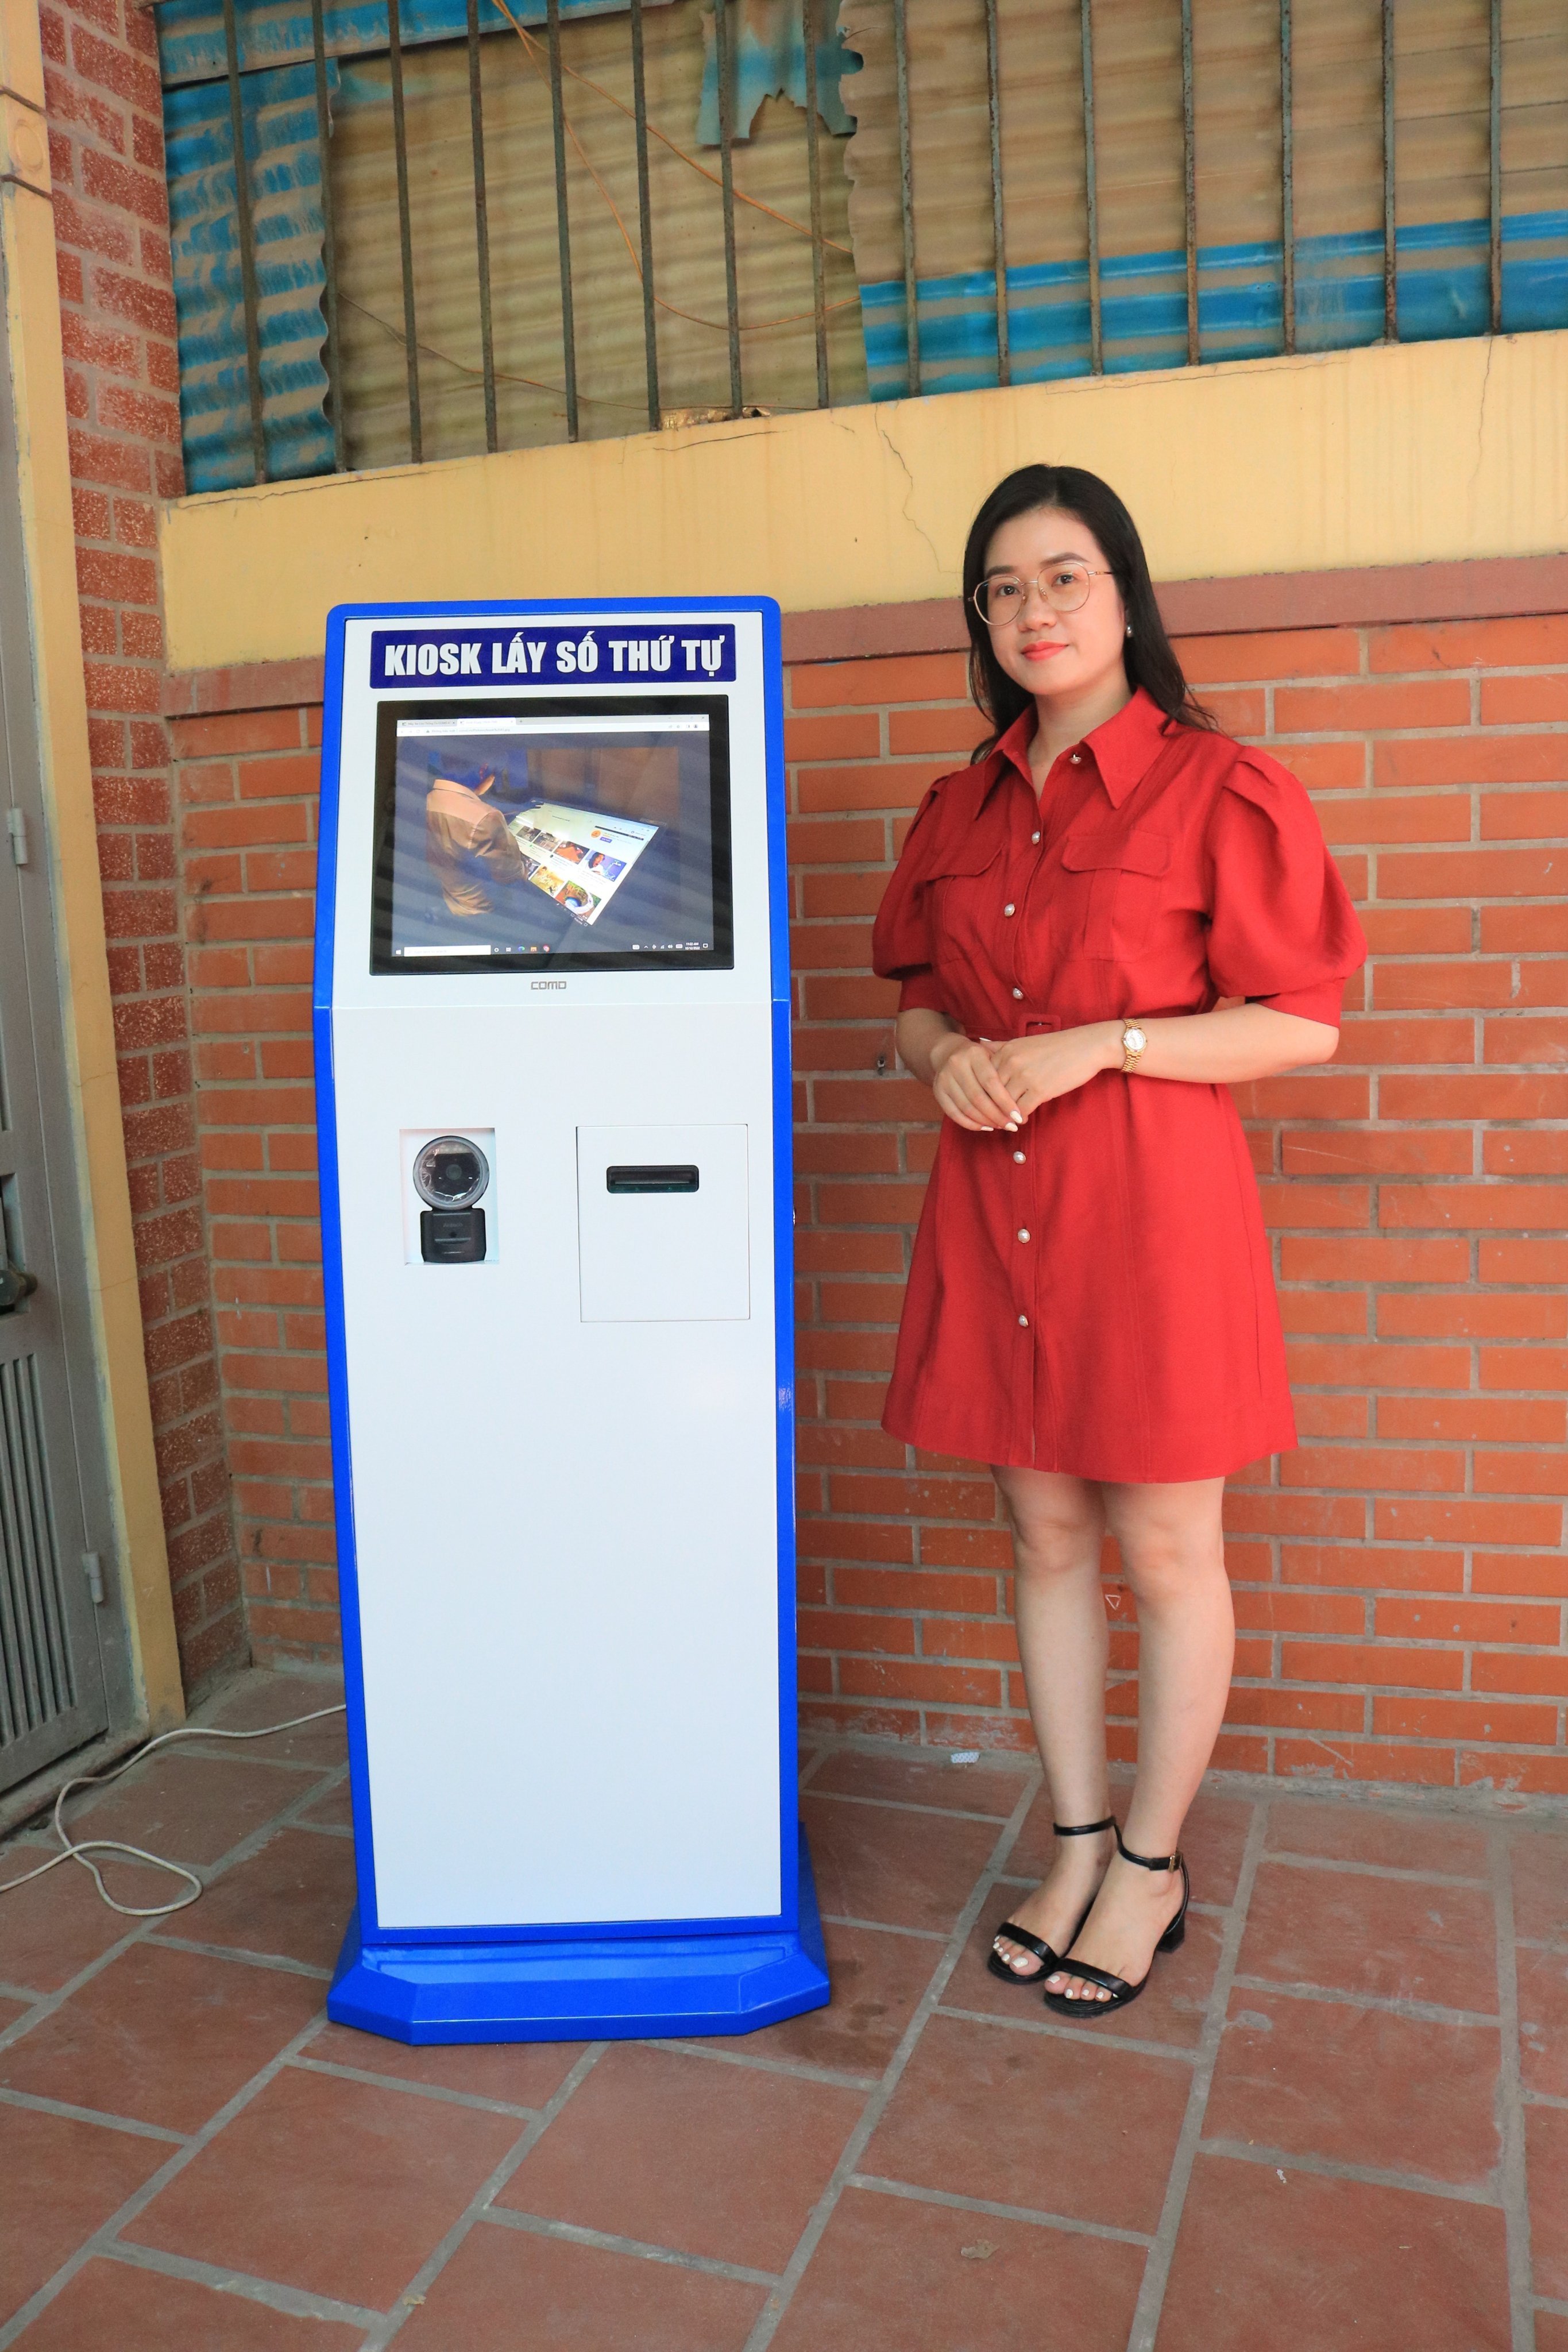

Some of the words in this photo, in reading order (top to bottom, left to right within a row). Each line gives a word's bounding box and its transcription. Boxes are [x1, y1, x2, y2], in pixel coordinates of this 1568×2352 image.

[384, 643, 482, 676] KIOSK
[492, 632, 547, 674] LẤY
[556, 631, 598, 673] SỐ
[609, 635, 675, 671] THỨ
[681, 635, 725, 677] TỰ
